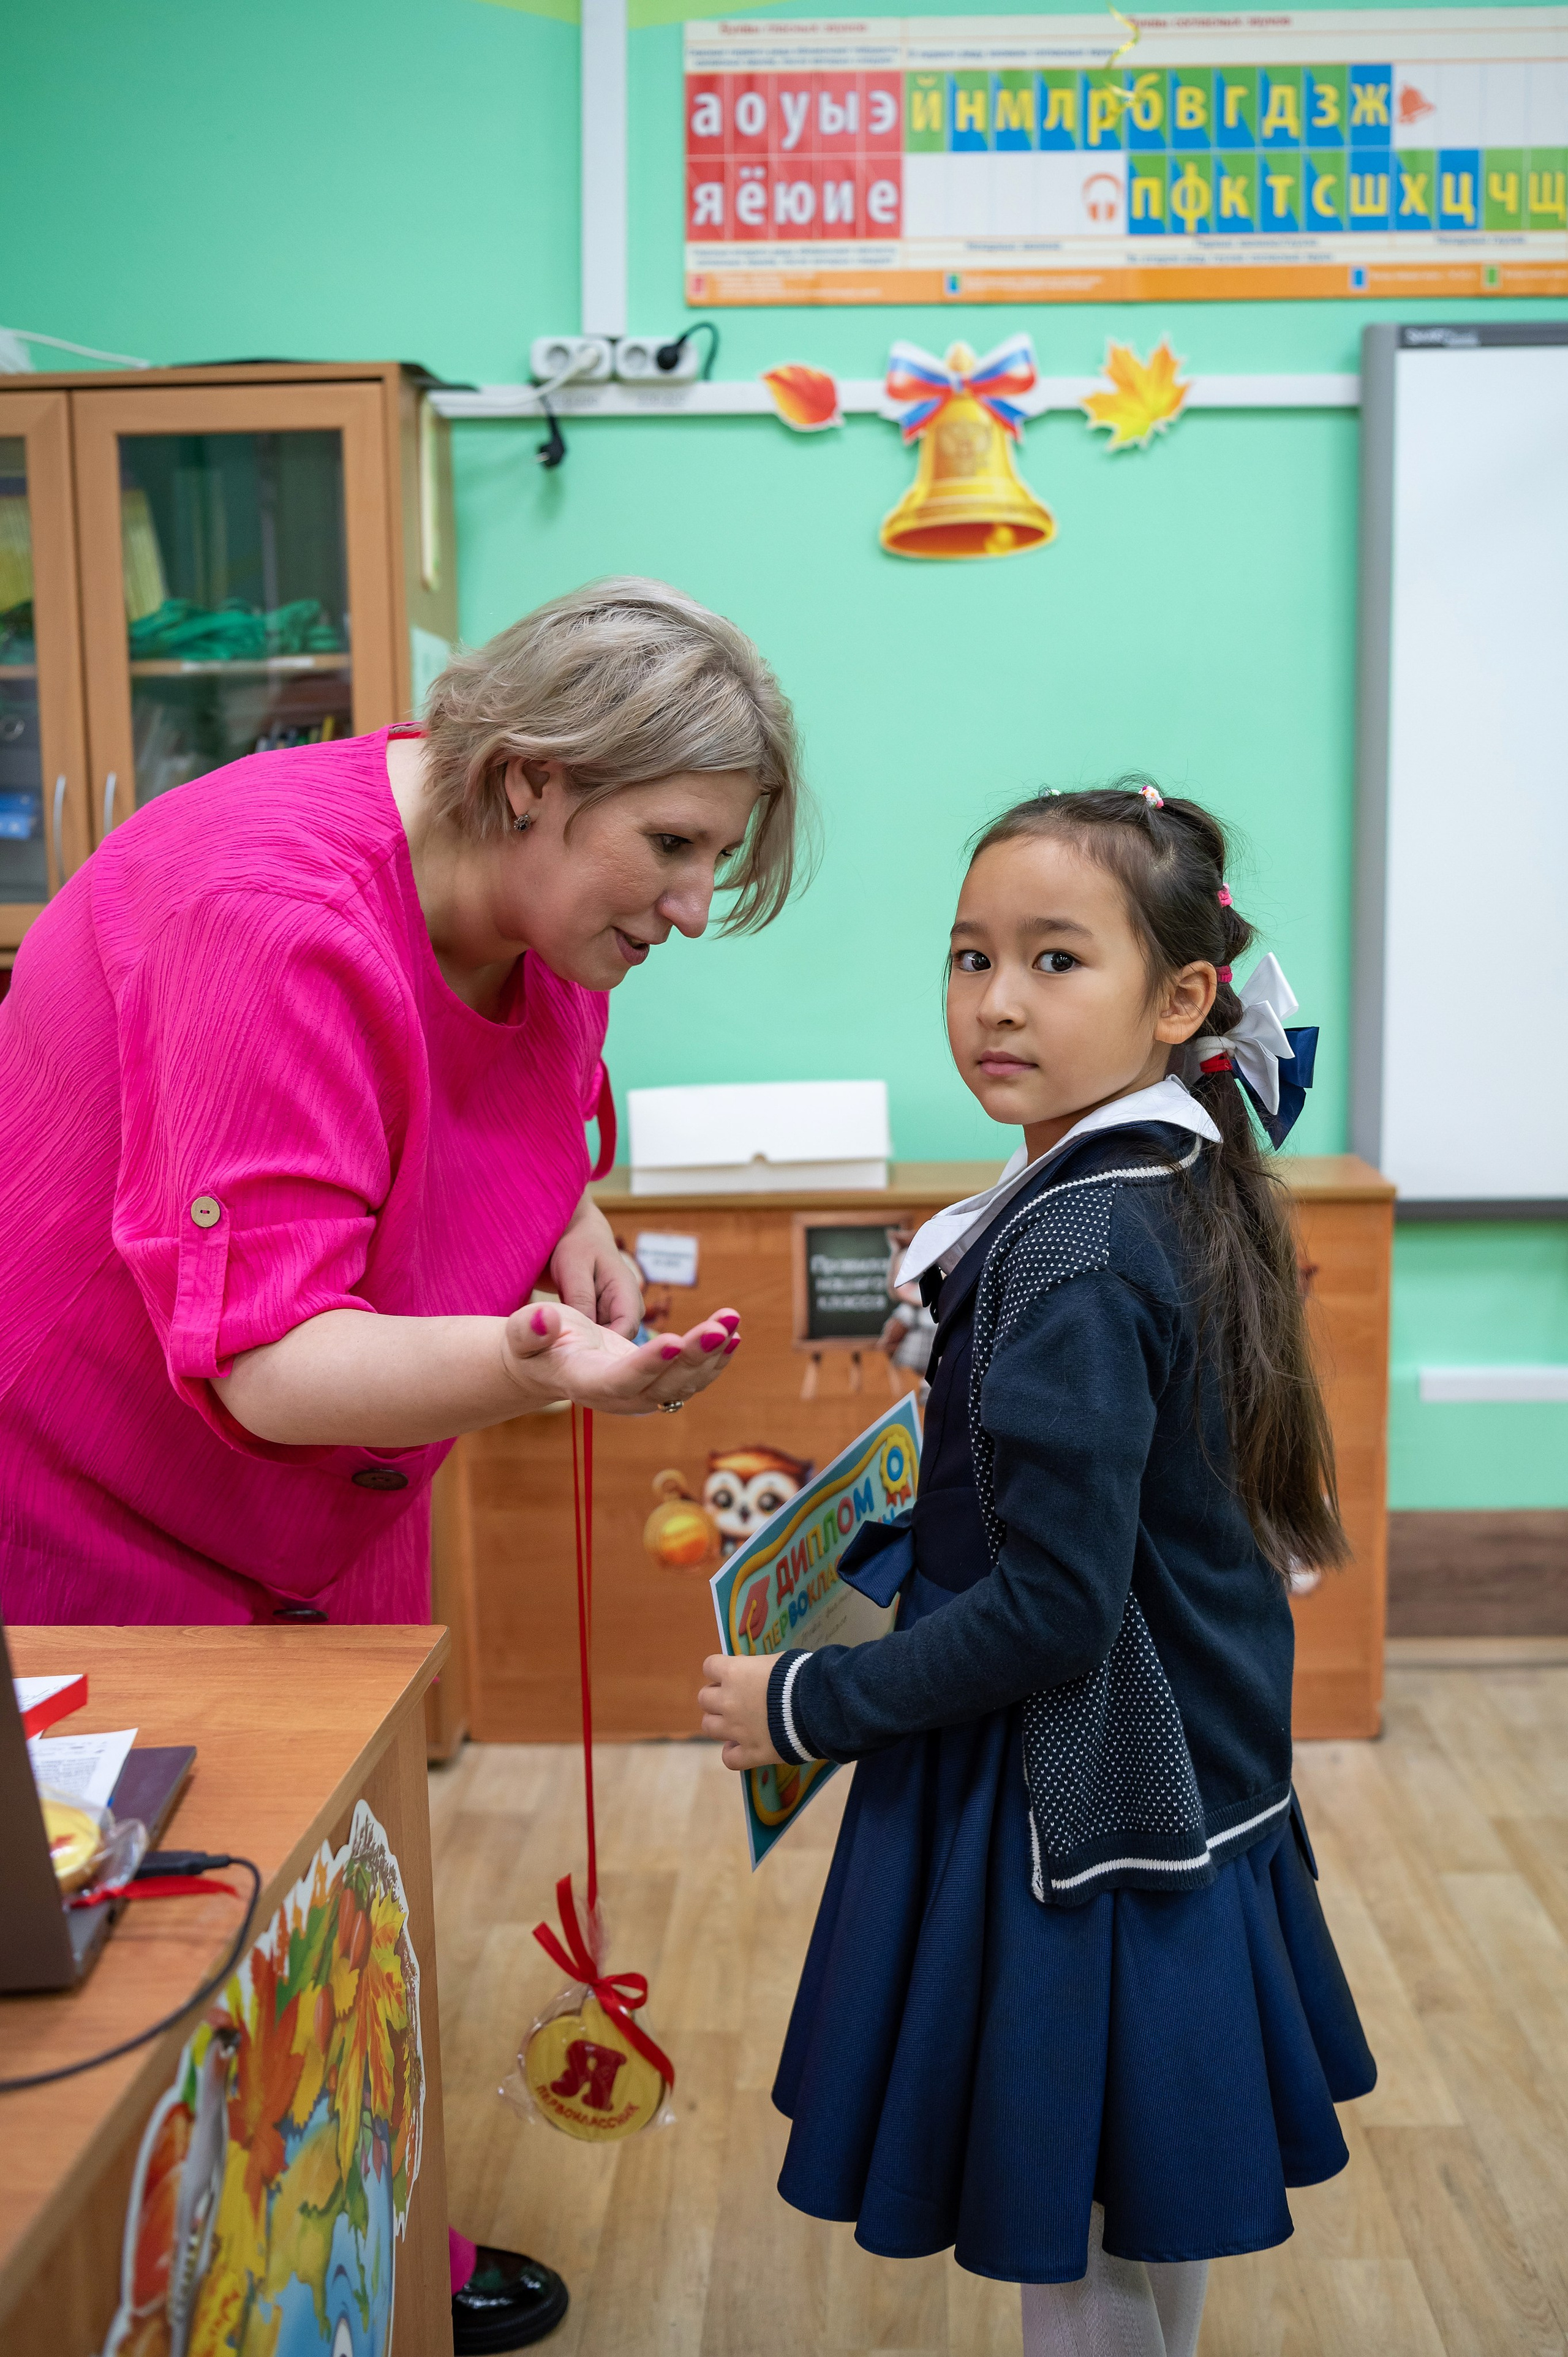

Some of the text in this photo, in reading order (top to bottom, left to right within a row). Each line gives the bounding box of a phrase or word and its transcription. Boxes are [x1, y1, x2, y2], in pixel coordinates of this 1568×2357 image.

[692, 92, 722, 136] а
[780, 91, 811, 150] у
[818, 90, 861, 135] ы
[869, 89, 899, 135] э
[910, 74, 943, 132] й
[956, 89, 987, 130] н
[997, 88, 1034, 130] м
[1044, 88, 1076, 130] л
[1131, 73, 1163, 130] б
[1177, 86, 1208, 129] в
[1225, 85, 1248, 127] г
[1263, 85, 1300, 138] д
[1312, 83, 1340, 127] з
[1351, 83, 1389, 126] ж
[693, 167, 899, 225] я ё ю и е
[1131, 176, 1163, 219] п
[1171, 162, 1212, 233] ф
[1221, 175, 1250, 217] к
[1266, 175, 1295, 217] т
[1351, 173, 1389, 216] ш
[1442, 173, 1475, 224] ц
[1487, 172, 1520, 214] ч
[775, 1477, 875, 1606] ДИПЛОМ
[550, 2039, 627, 2111] Я
